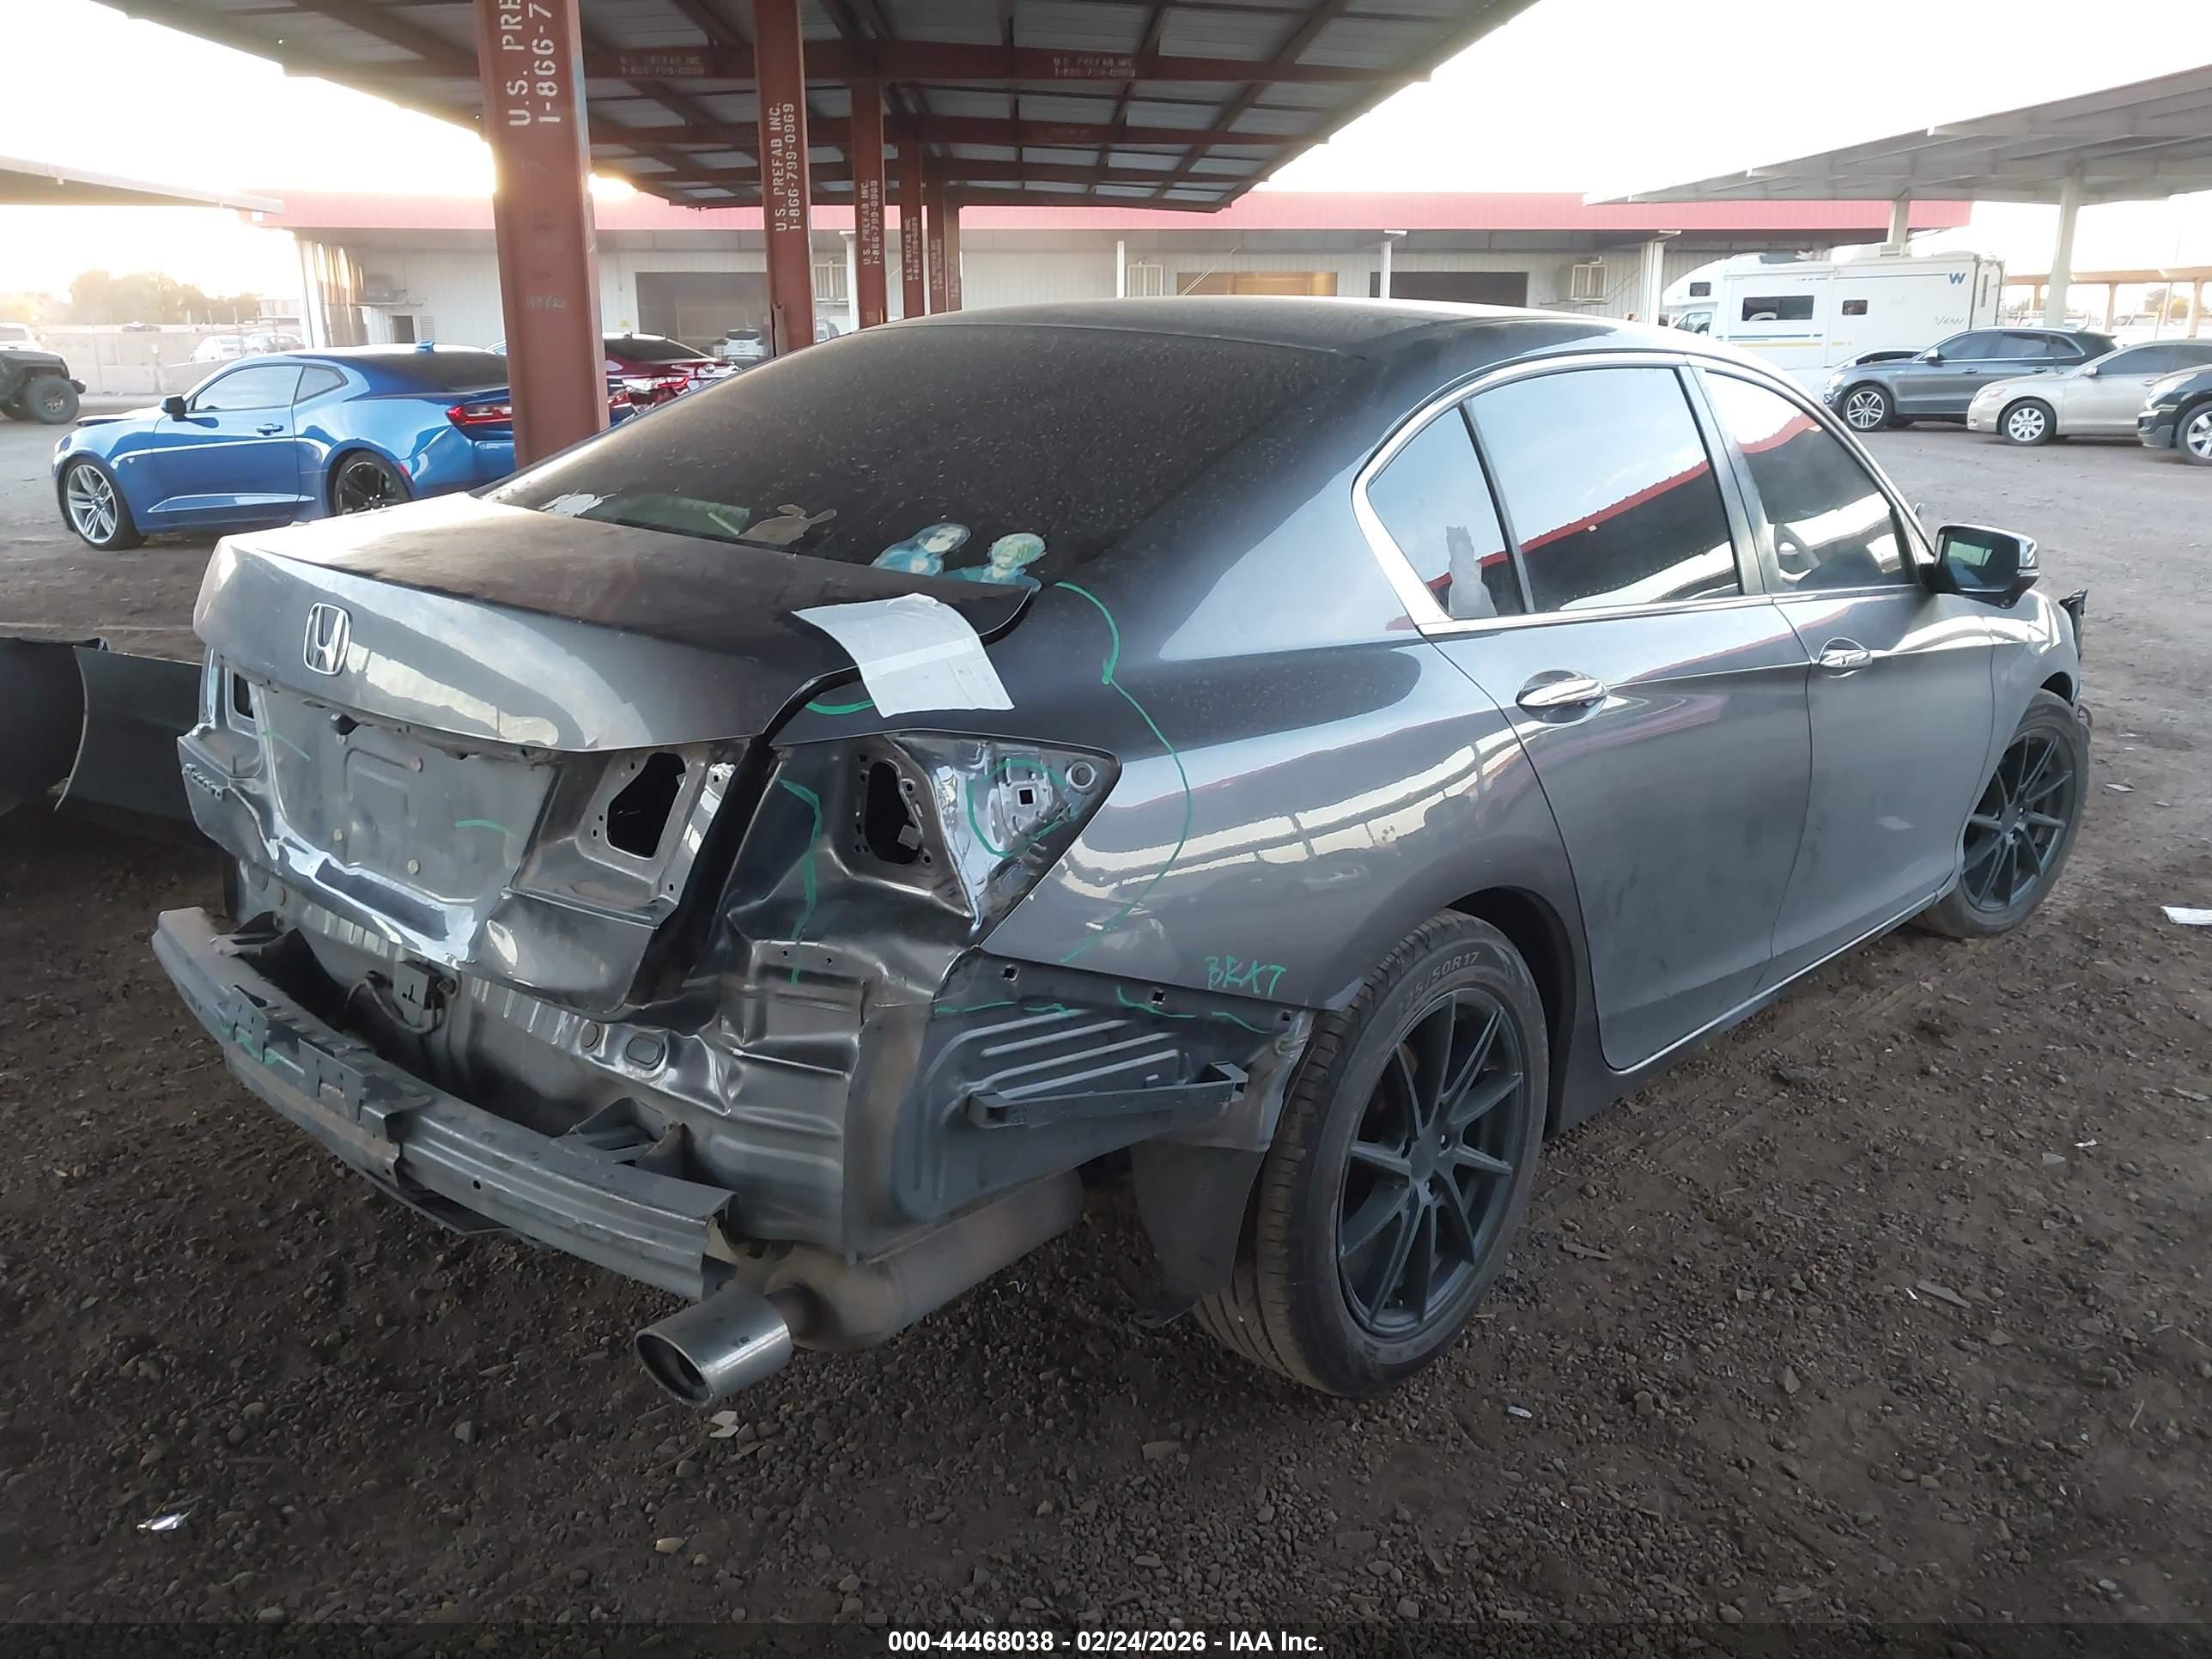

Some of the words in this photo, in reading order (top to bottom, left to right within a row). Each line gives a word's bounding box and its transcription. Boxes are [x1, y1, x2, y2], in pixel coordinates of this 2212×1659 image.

[529, 3, 561, 123] 1-866-7
[507, 70, 532, 126] U.S.
[769, 102, 781, 131] INC.
[770, 138, 785, 196] PREFAB
[782, 103, 802, 229] 1-866-799-0969
[775, 204, 787, 232] U.S.
[861, 203, 871, 241] PREFAB
[1949, 272, 1966, 285] W
